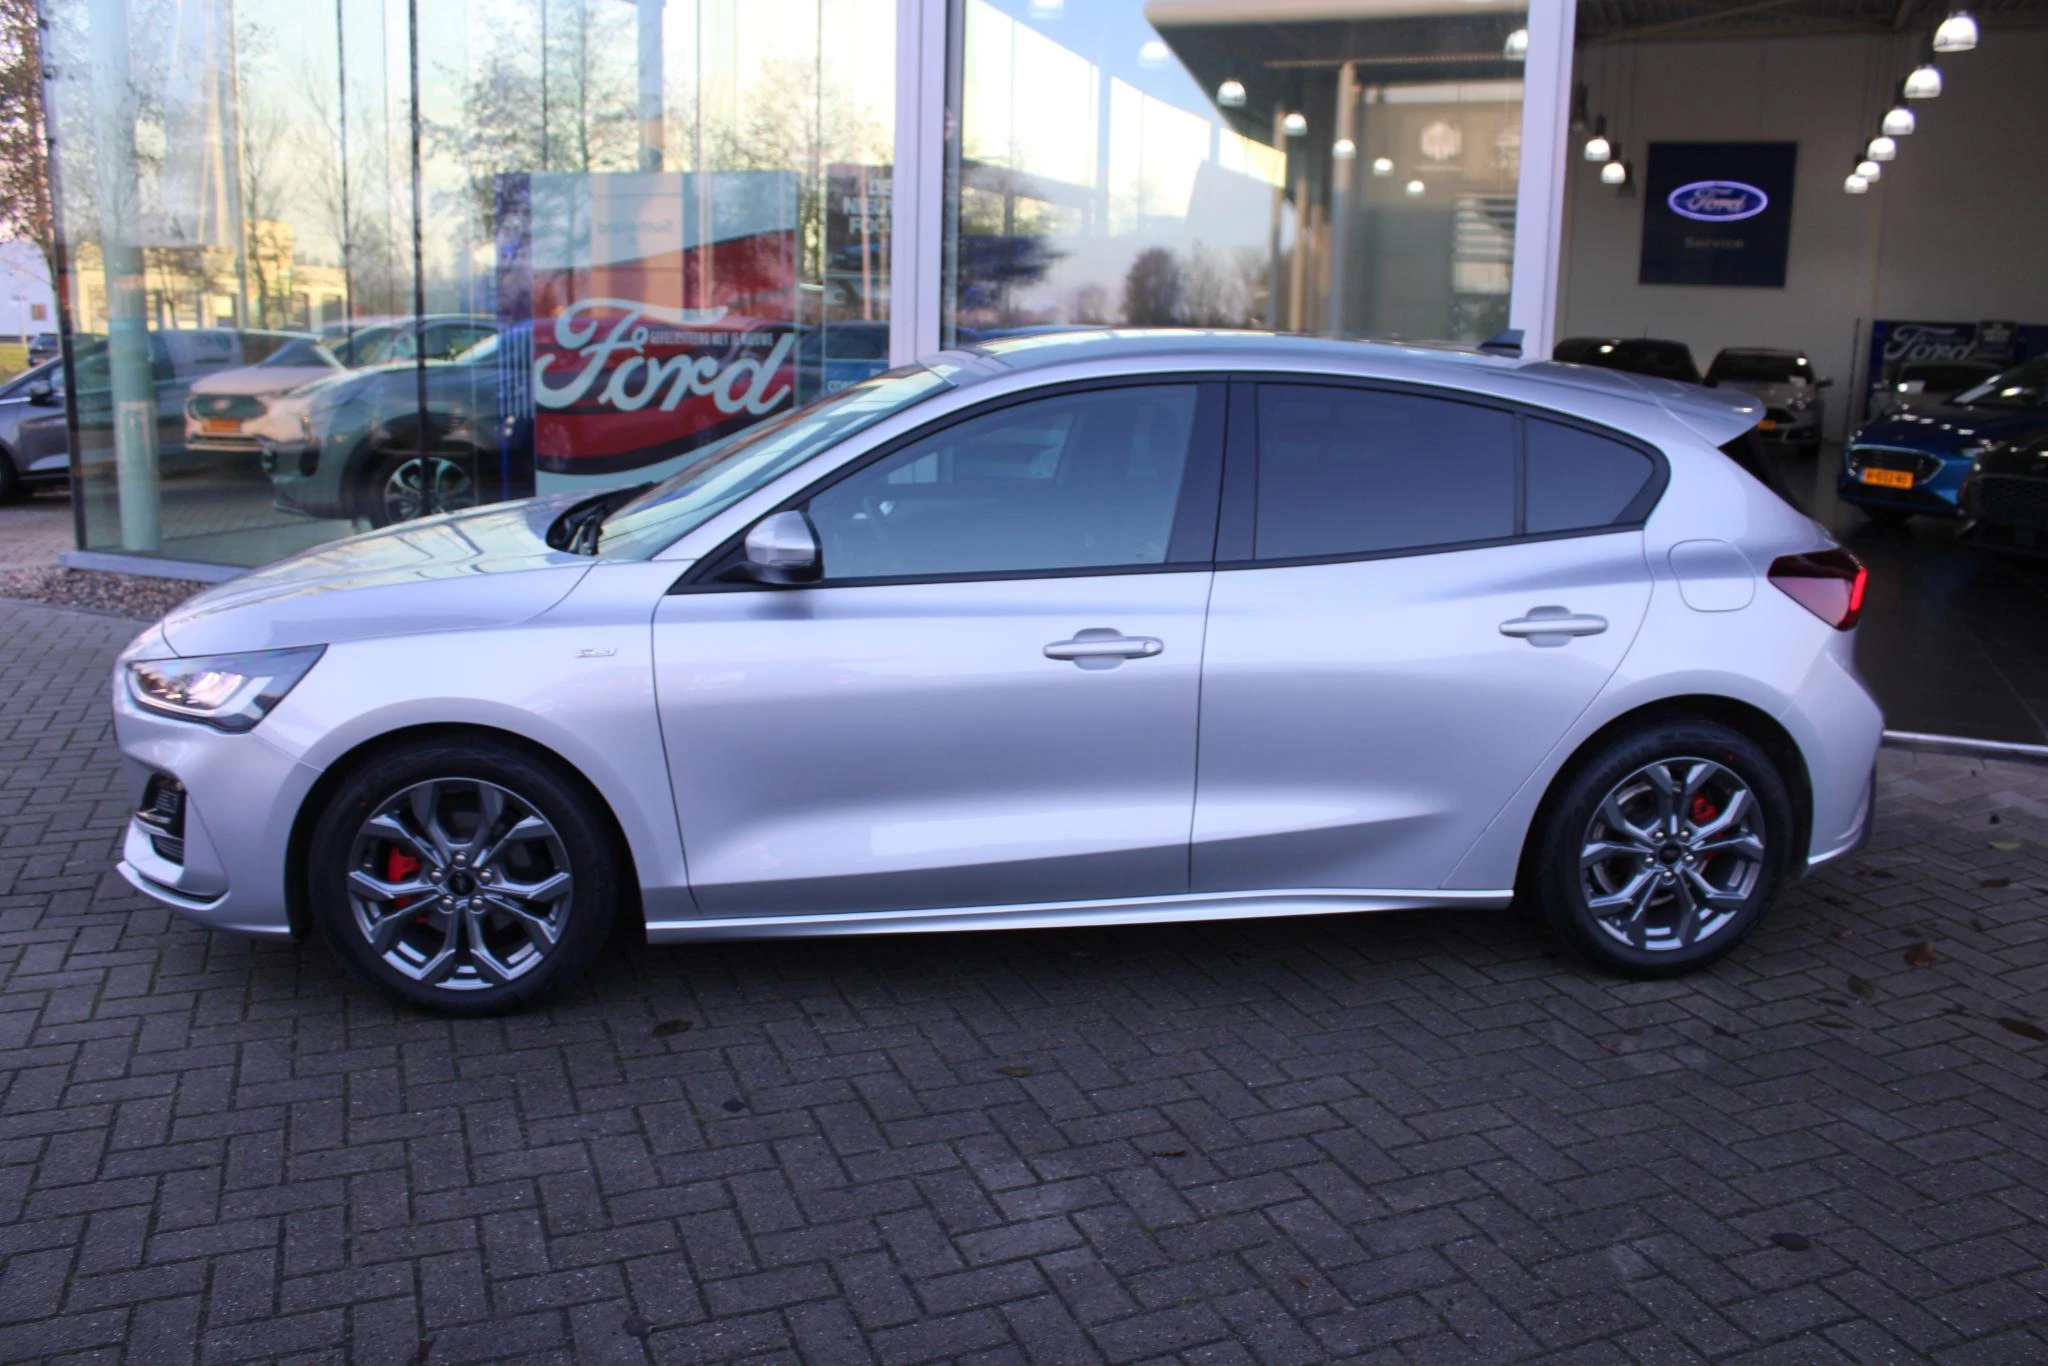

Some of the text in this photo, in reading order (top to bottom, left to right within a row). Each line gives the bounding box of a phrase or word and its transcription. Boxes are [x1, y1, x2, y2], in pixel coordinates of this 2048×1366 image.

[1685, 187, 1748, 211] Ford
[1684, 235, 1744, 249] Service
[534, 298, 796, 415] Ford
[1884, 324, 1978, 361] Ford
